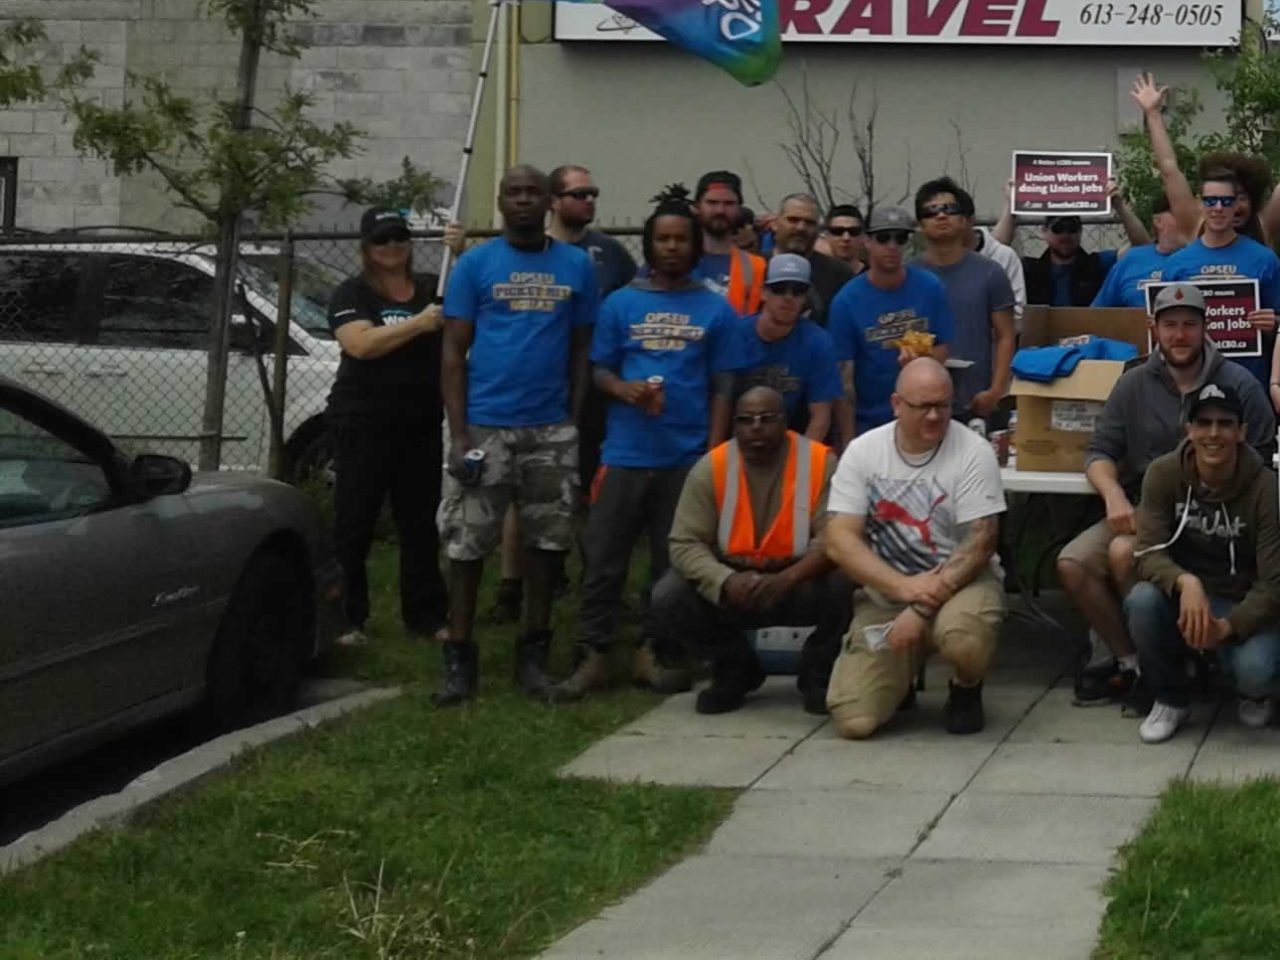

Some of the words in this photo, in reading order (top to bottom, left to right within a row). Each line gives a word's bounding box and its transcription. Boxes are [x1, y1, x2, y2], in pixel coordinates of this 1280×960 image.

[1079, 3, 1225, 27] 613-248-0505
[1024, 172, 1056, 182] Union
[1057, 172, 1098, 182] Workers
[1019, 183, 1048, 195] doing
[1049, 184, 1080, 193] Union
[1081, 183, 1103, 194] Jobs
[1227, 318, 1251, 331] Jobs
